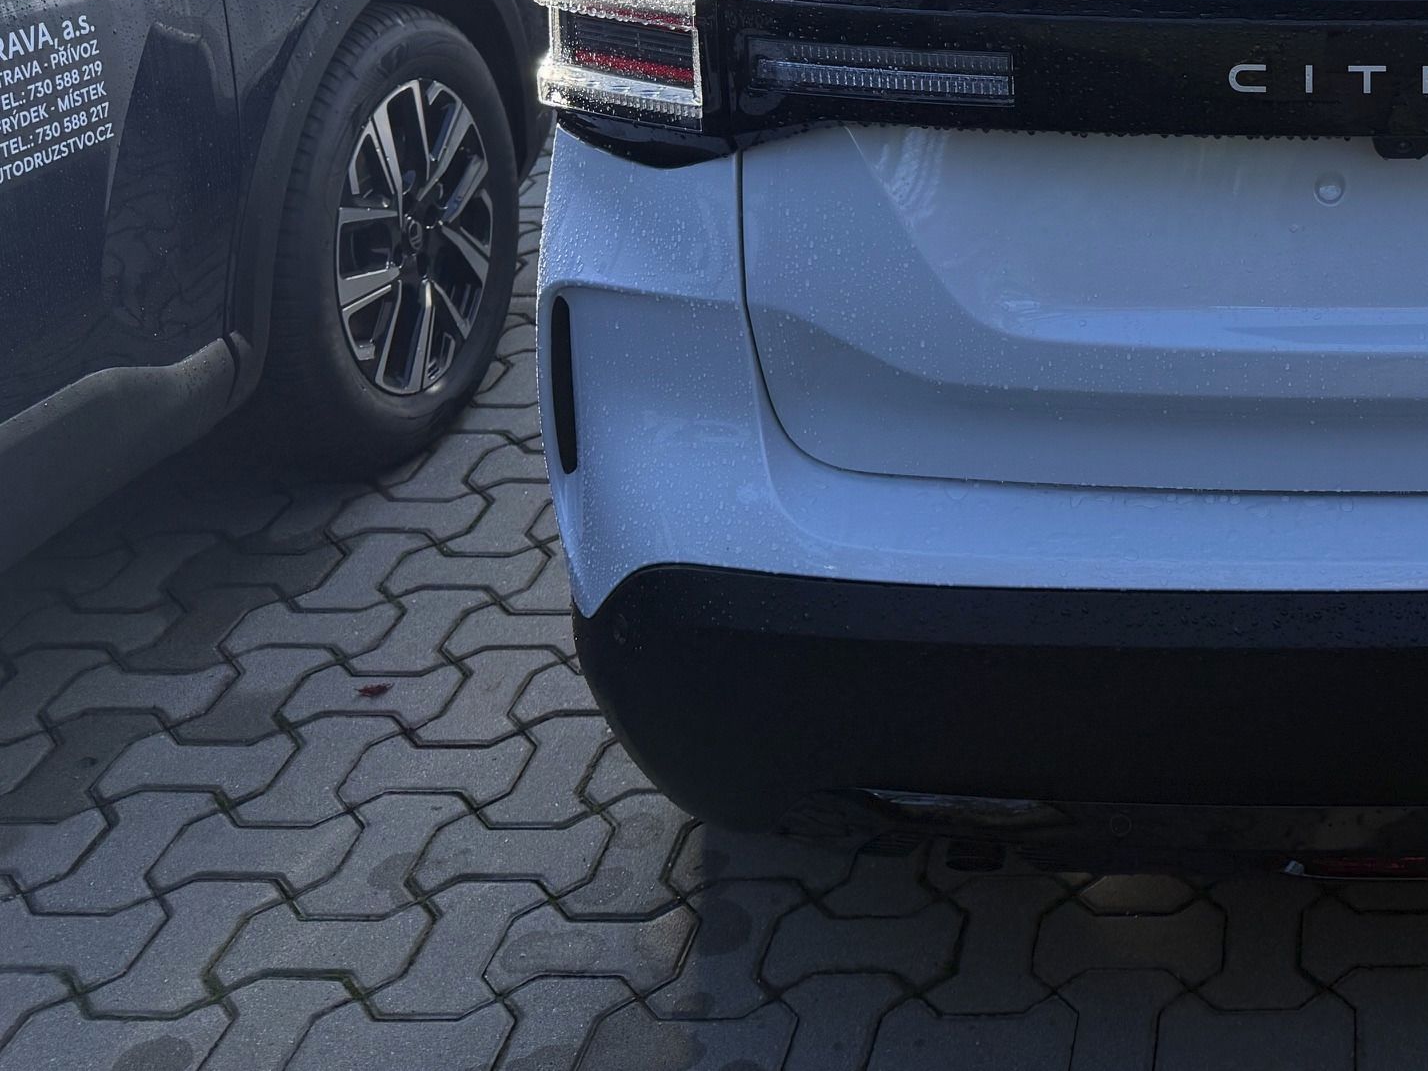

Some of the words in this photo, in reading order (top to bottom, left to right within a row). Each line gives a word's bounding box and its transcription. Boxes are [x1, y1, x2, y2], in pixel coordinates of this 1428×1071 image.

[62, 15, 95, 40] a.s.
[0, 60, 42, 88] RAVA
[51, 39, 100, 69] PŘÍVOZ
[27, 79, 51, 100] 730
[56, 68, 80, 90] 588
[82, 61, 103, 80] 219
[0, 103, 49, 134] RÝDEK
[57, 81, 107, 113] MÍSTEK
[0, 135, 34, 158] TEL.:
[35, 122, 61, 144] 730
[64, 111, 88, 133] 588
[90, 102, 110, 122] 217
